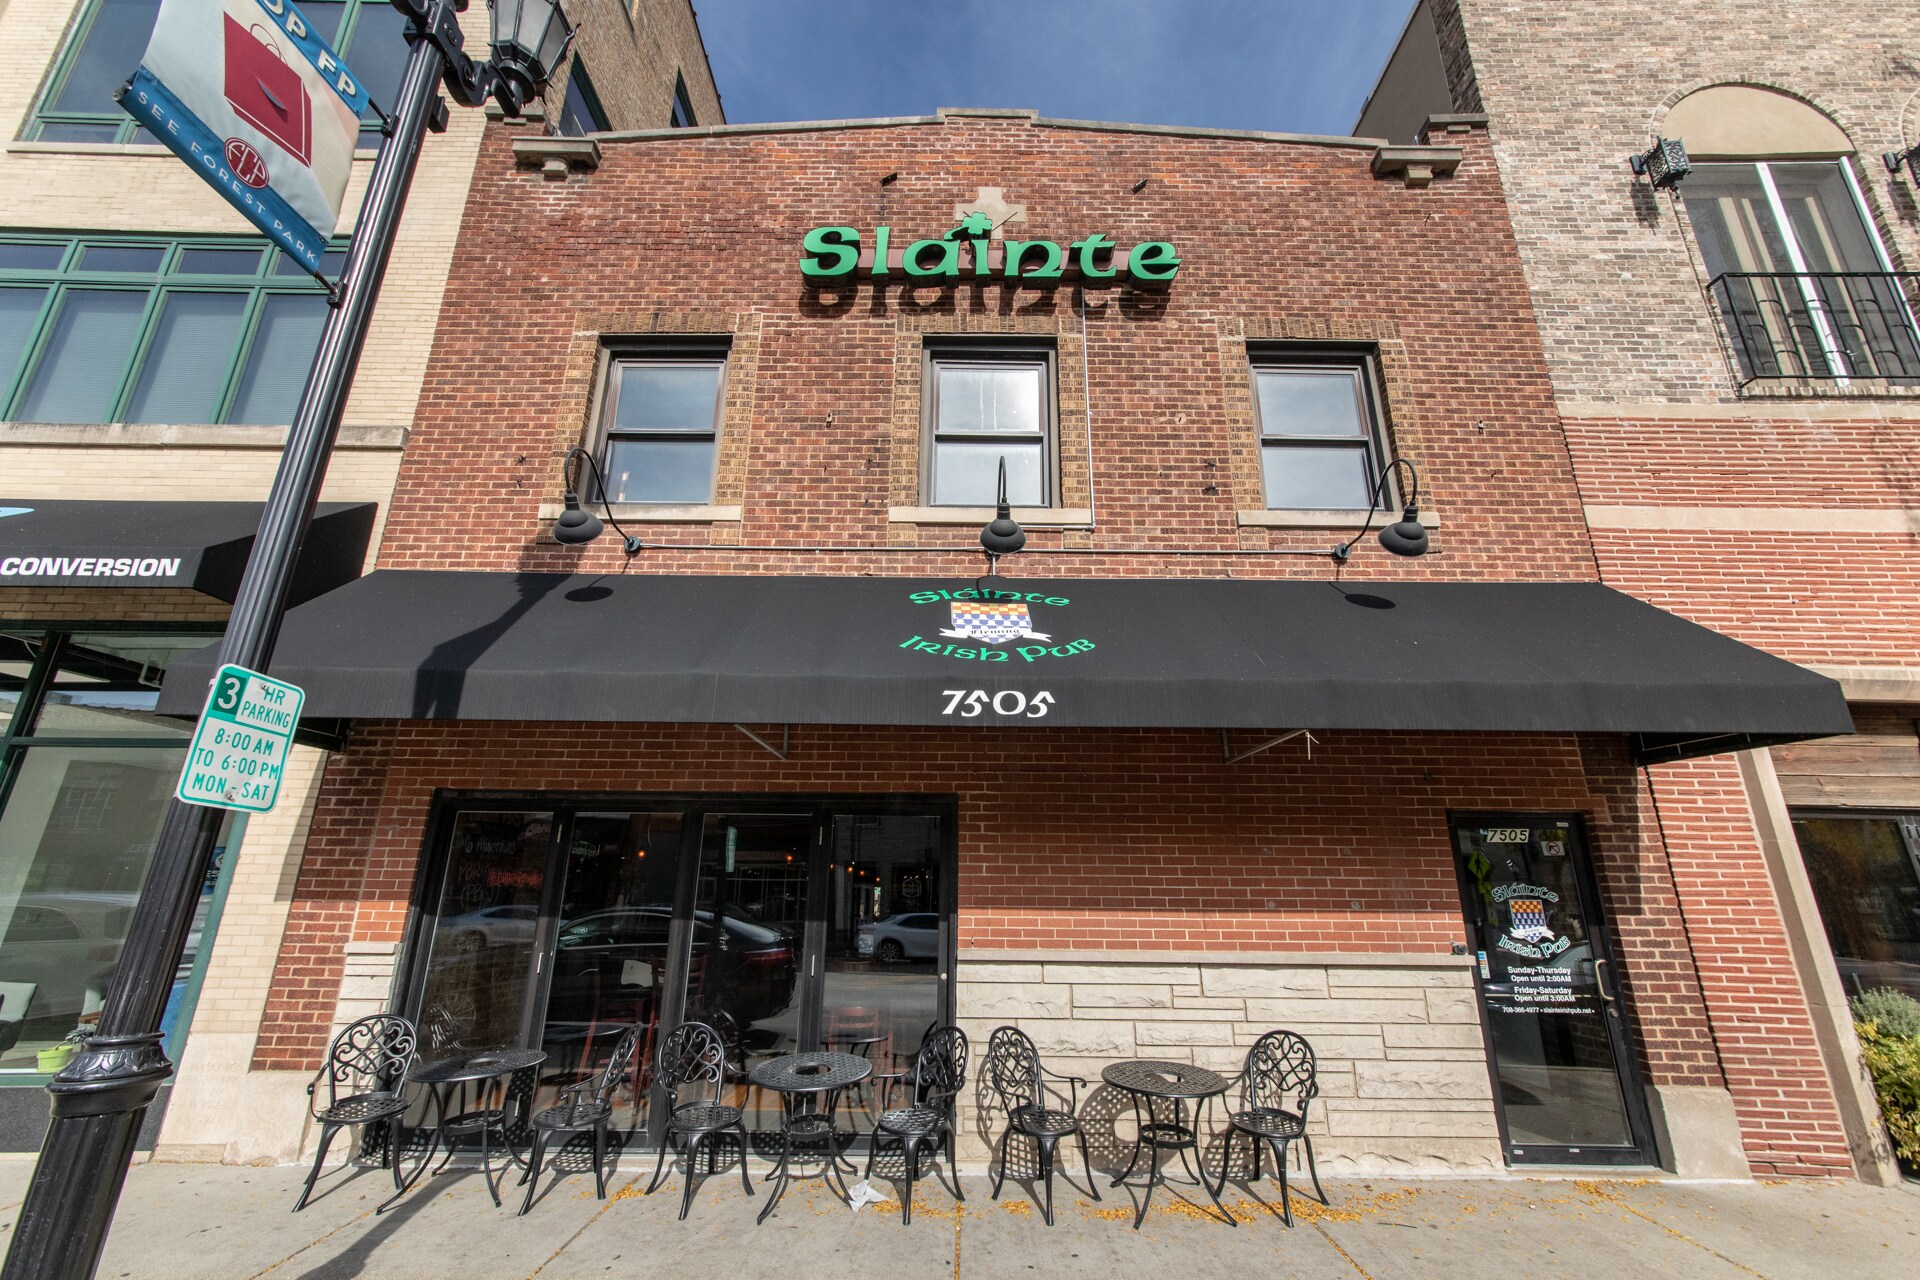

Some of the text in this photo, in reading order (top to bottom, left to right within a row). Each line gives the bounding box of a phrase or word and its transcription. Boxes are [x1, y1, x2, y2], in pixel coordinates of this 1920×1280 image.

[318, 49, 356, 96] FP
[138, 91, 315, 263] SEE FOREST PARK
[0, 557, 182, 577] CONVERSION
[217, 677, 286, 709] 3 HR
[942, 690, 1056, 717] 7505
[241, 700, 291, 728] PARKING
[214, 728, 274, 756] 8:00 AM
[195, 748, 280, 780] TO 6:00 PM
[192, 773, 227, 794] MON
[241, 782, 270, 800] SAT
[1489, 829, 1528, 842] 7505
[1507, 966, 1571, 975] Sunday-Thursday
[1511, 975, 1529, 983] Open
[1514, 987, 1571, 995] Friday-Saturday
[1514, 995, 1533, 1003] Open
